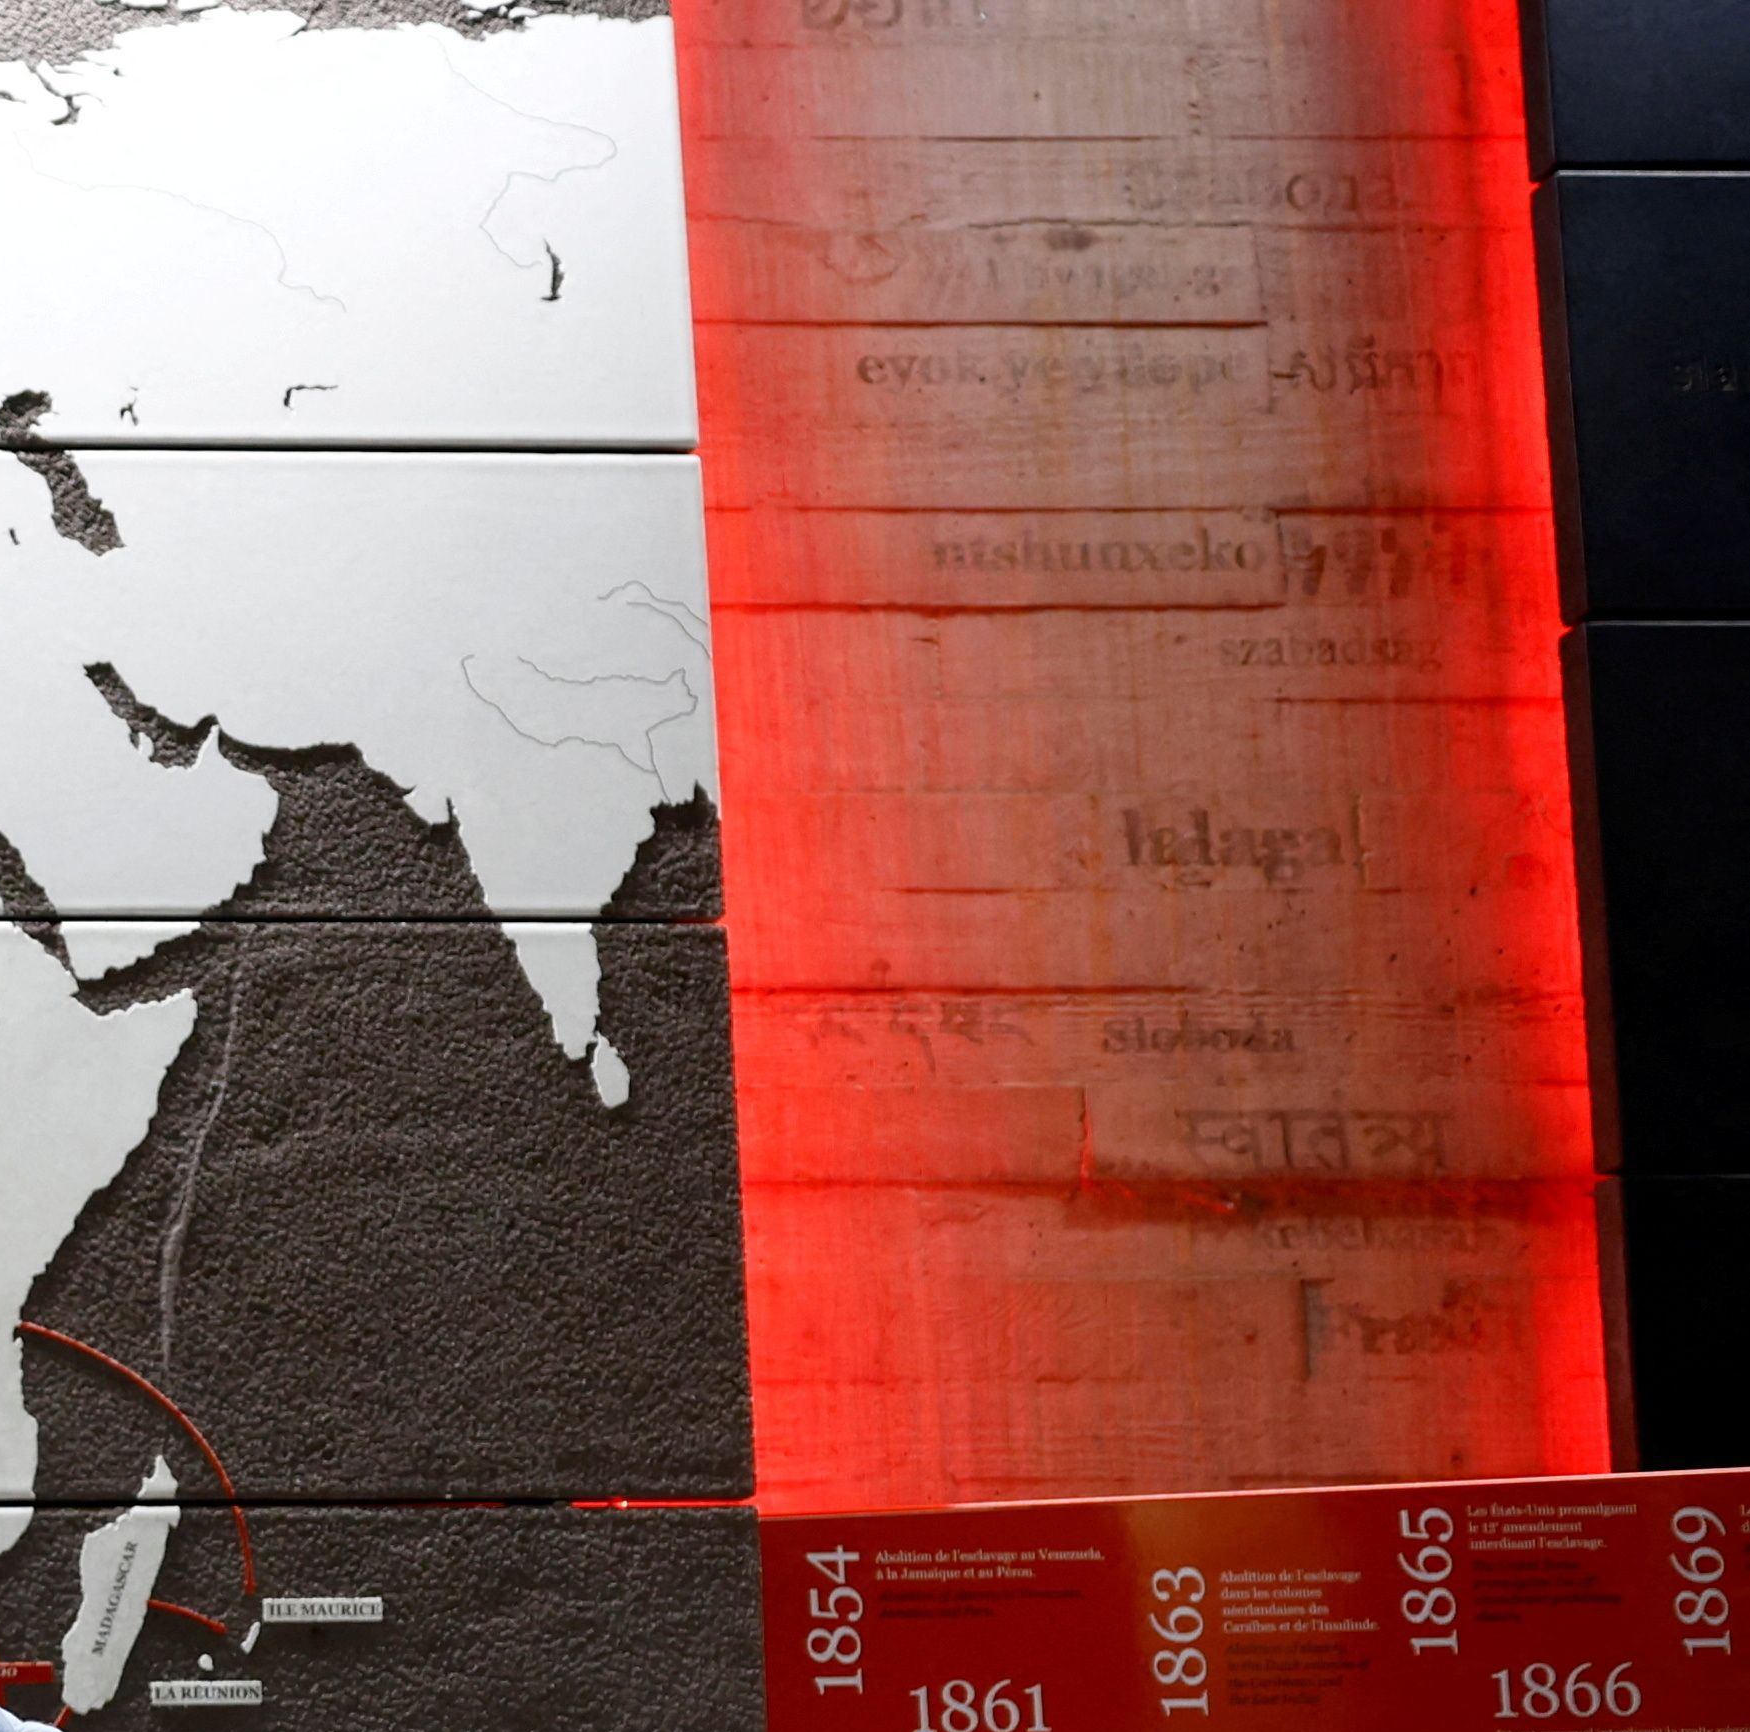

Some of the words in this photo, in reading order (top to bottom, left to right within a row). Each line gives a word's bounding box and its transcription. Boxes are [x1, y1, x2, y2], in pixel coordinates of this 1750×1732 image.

[1503, 1520, 1583, 1533] amendement
[1470, 1536, 1537, 1551] interdisant
[875, 1550, 932, 1564] Abolition
[935, 1550, 950, 1563] de
[953, 1549, 1018, 1565] l'esclavage
[886, 1567, 899, 1580] la
[963, 1567, 976, 1579] et
[978, 1568, 993, 1579] au
[1220, 1570, 1276, 1584] Abolition
[1279, 1570, 1294, 1582] de
[1669, 1506, 1732, 1656] 1869
[1397, 1507, 1459, 1656] 1865
[91, 1541, 138, 1656] MADAGASCAR
[1221, 1587, 1250, 1600] dans
[1253, 1587, 1271, 1599] les
[1272, 1586, 1323, 1600] colonies
[268, 1603, 295, 1617] ILE
[301, 1602, 382, 1617] MAURICE
[1309, 1603, 1329, 1616] des
[806, 1544, 864, 1696] 1854
[1279, 1620, 1291, 1632] et
[1293, 1619, 1309, 1632] de
[1148, 1566, 1210, 1717] 1863
[154, 1686, 176, 1700] LA
[180, 1683, 262, 1701] RÉUNION
[1491, 1662, 1642, 1719] 1866
